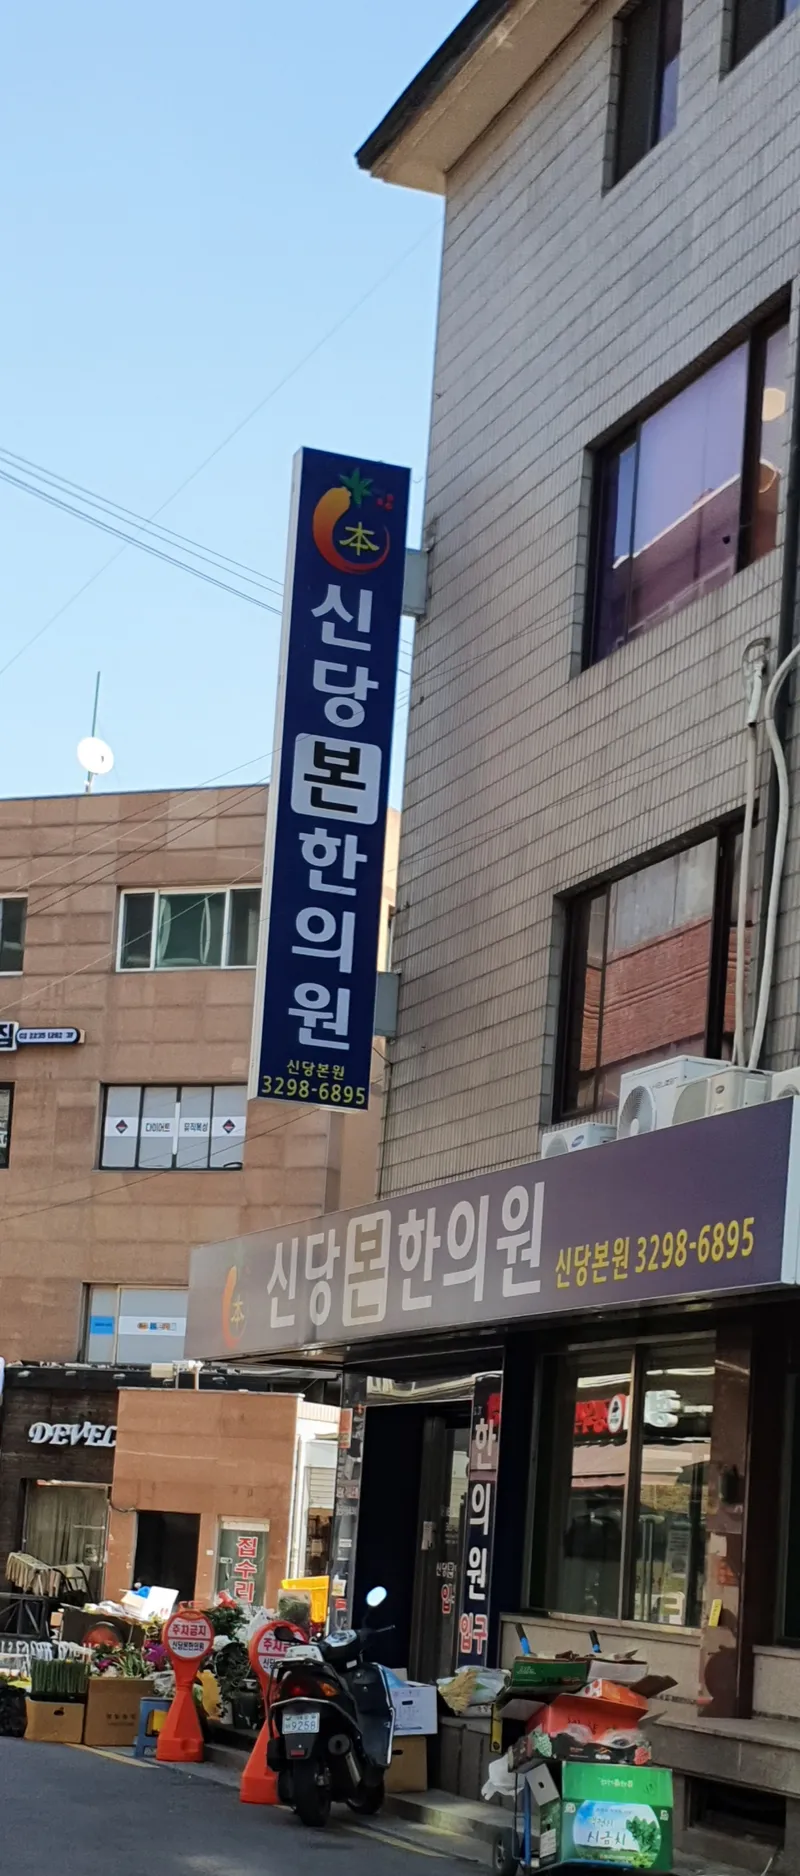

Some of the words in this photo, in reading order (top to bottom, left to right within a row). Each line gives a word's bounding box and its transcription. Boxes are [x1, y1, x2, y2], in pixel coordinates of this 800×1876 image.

[338, 521, 380, 556] 本
[286, 1058, 346, 1081] 신당본원
[260, 1073, 367, 1108] 3298-6895
[145, 1122, 171, 1133] 다이어트
[555, 1235, 631, 1290] 신당본원
[634, 1217, 755, 1273] 3298-6895
[467, 1417, 497, 1601] 한의원
[234, 1536, 259, 1604] 집수리
[172, 1624, 207, 1637] 주차금지
[459, 1611, 488, 1655] 입구
[291, 1720, 317, 1732] 9258
[586, 1830, 627, 1846] 시금치
